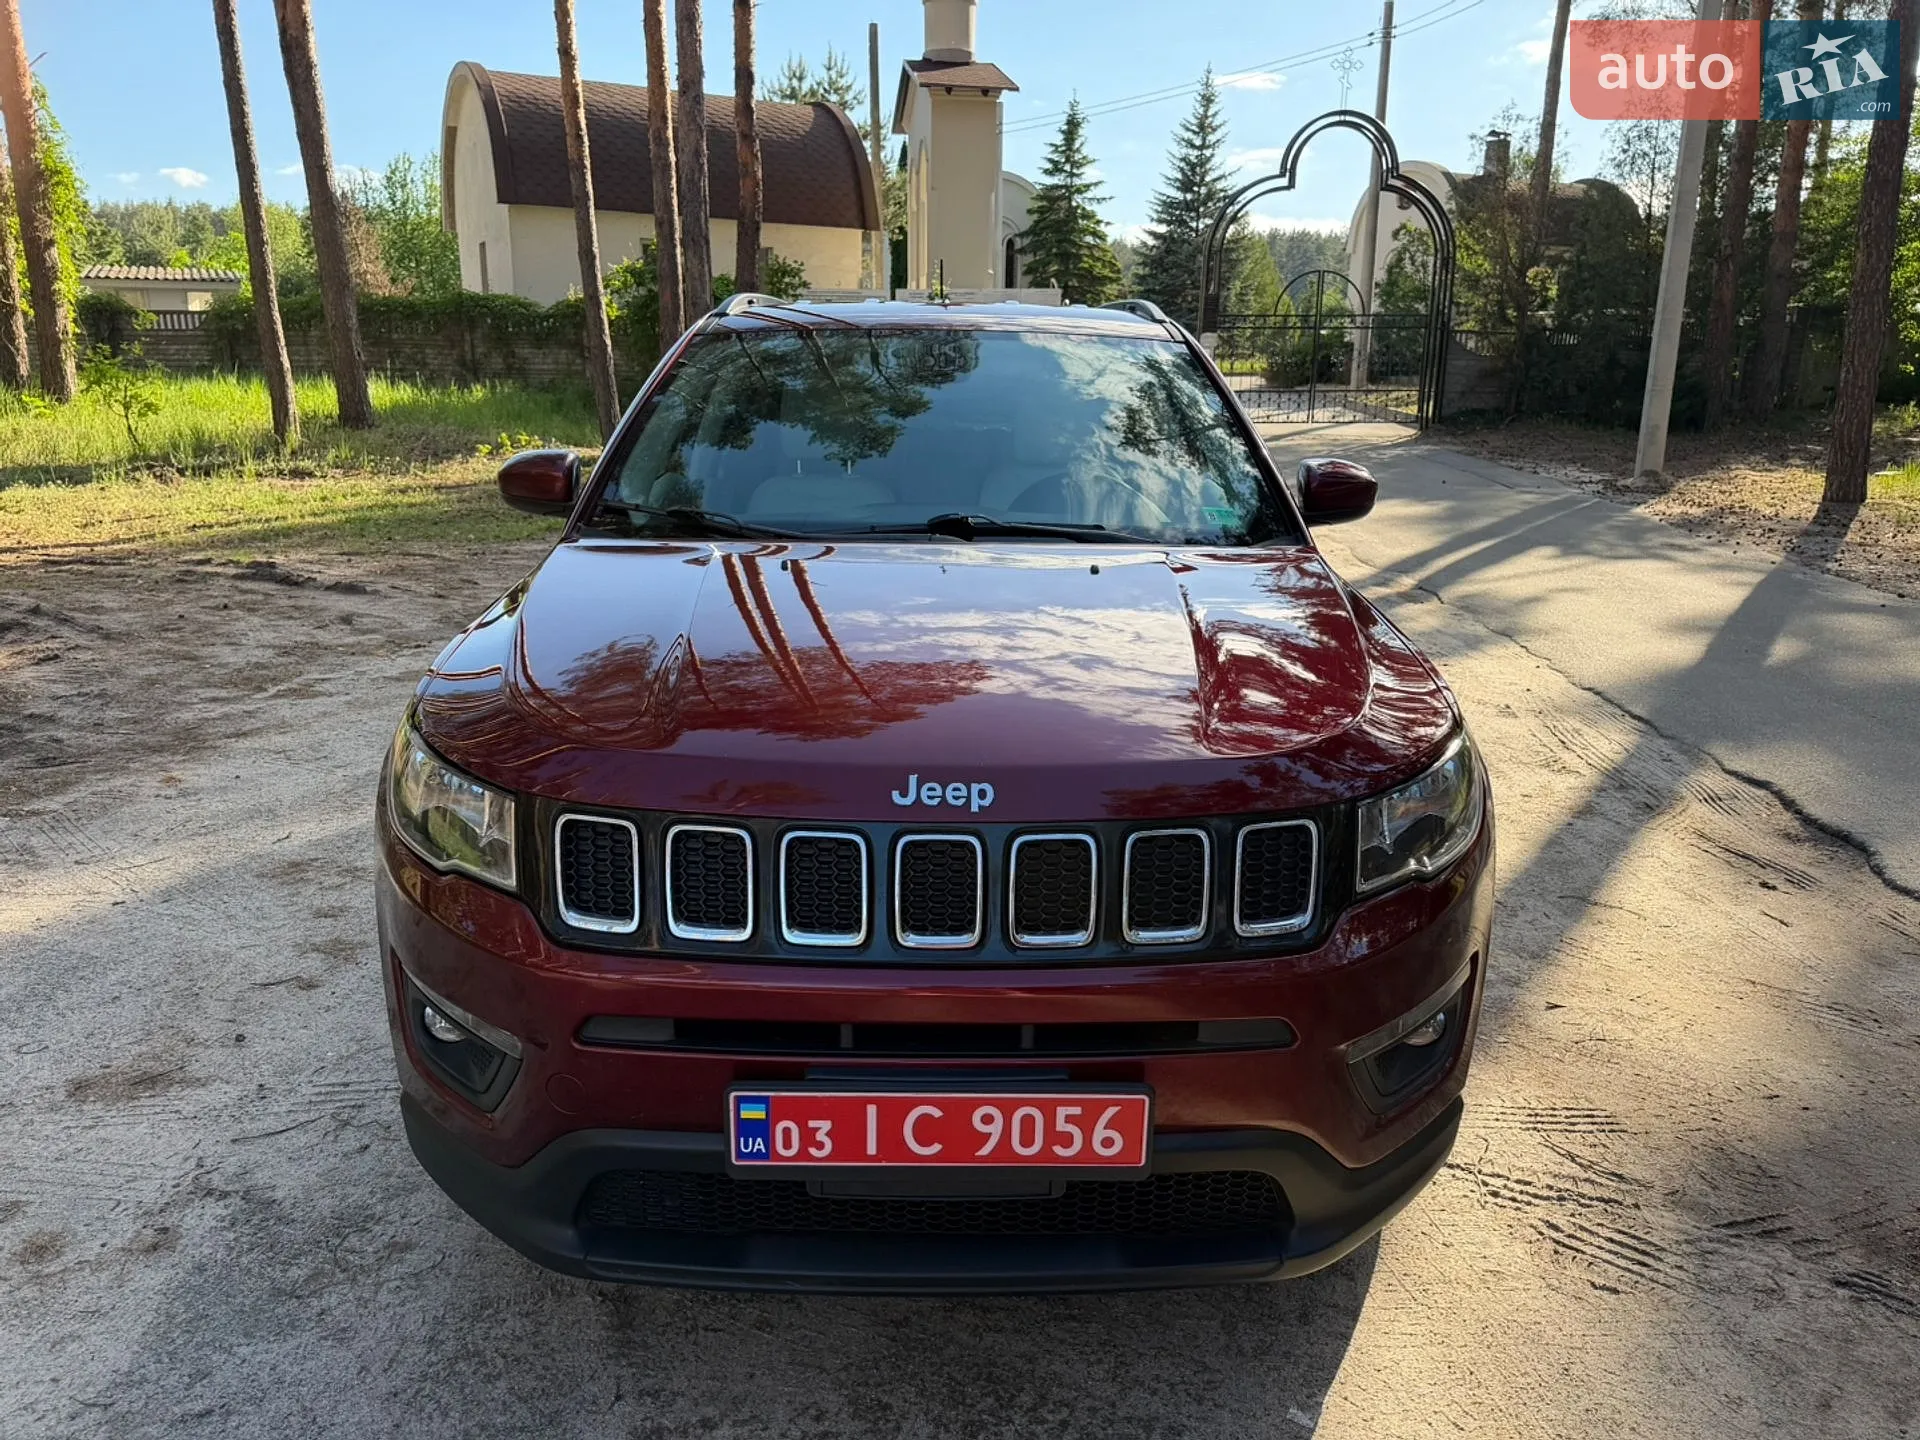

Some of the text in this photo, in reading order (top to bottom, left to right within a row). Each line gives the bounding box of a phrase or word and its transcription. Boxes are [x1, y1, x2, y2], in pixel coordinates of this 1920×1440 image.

[891, 774, 995, 812] Jeep
[740, 1137, 766, 1153] UA
[775, 1120, 833, 1157] 03
[972, 1105, 1124, 1157] 9056
